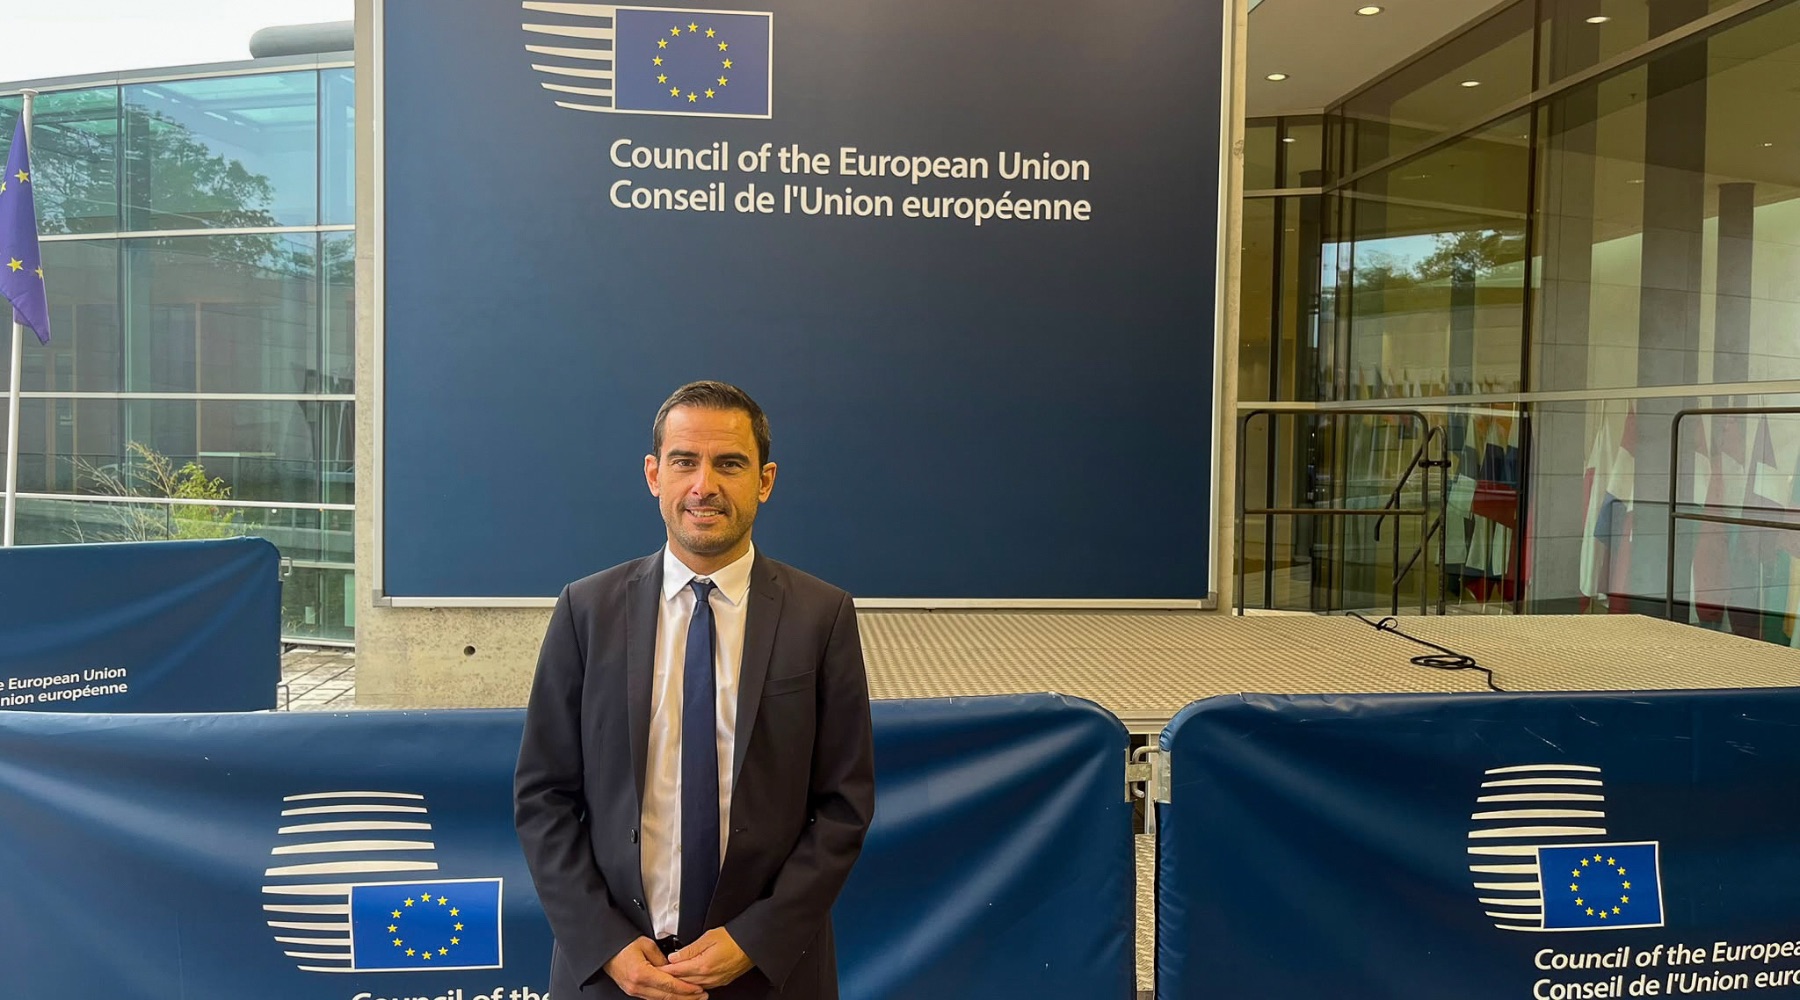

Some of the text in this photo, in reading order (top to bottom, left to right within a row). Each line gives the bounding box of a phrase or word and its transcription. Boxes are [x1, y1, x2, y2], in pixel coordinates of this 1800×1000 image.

[609, 138, 1090, 185] Council of the European Union
[609, 179, 1092, 226] Conseil de l'Union européenne
[8, 673, 80, 690] European
[83, 667, 127, 682] Union
[38, 683, 128, 702] européenne
[1534, 946, 1631, 971] Council
[1635, 944, 1664, 968] of
[1666, 943, 1707, 966] the
[1533, 974, 1624, 1000] Conseil
[1628, 973, 1661, 997] de
[1665, 970, 1749, 995] l'Union
